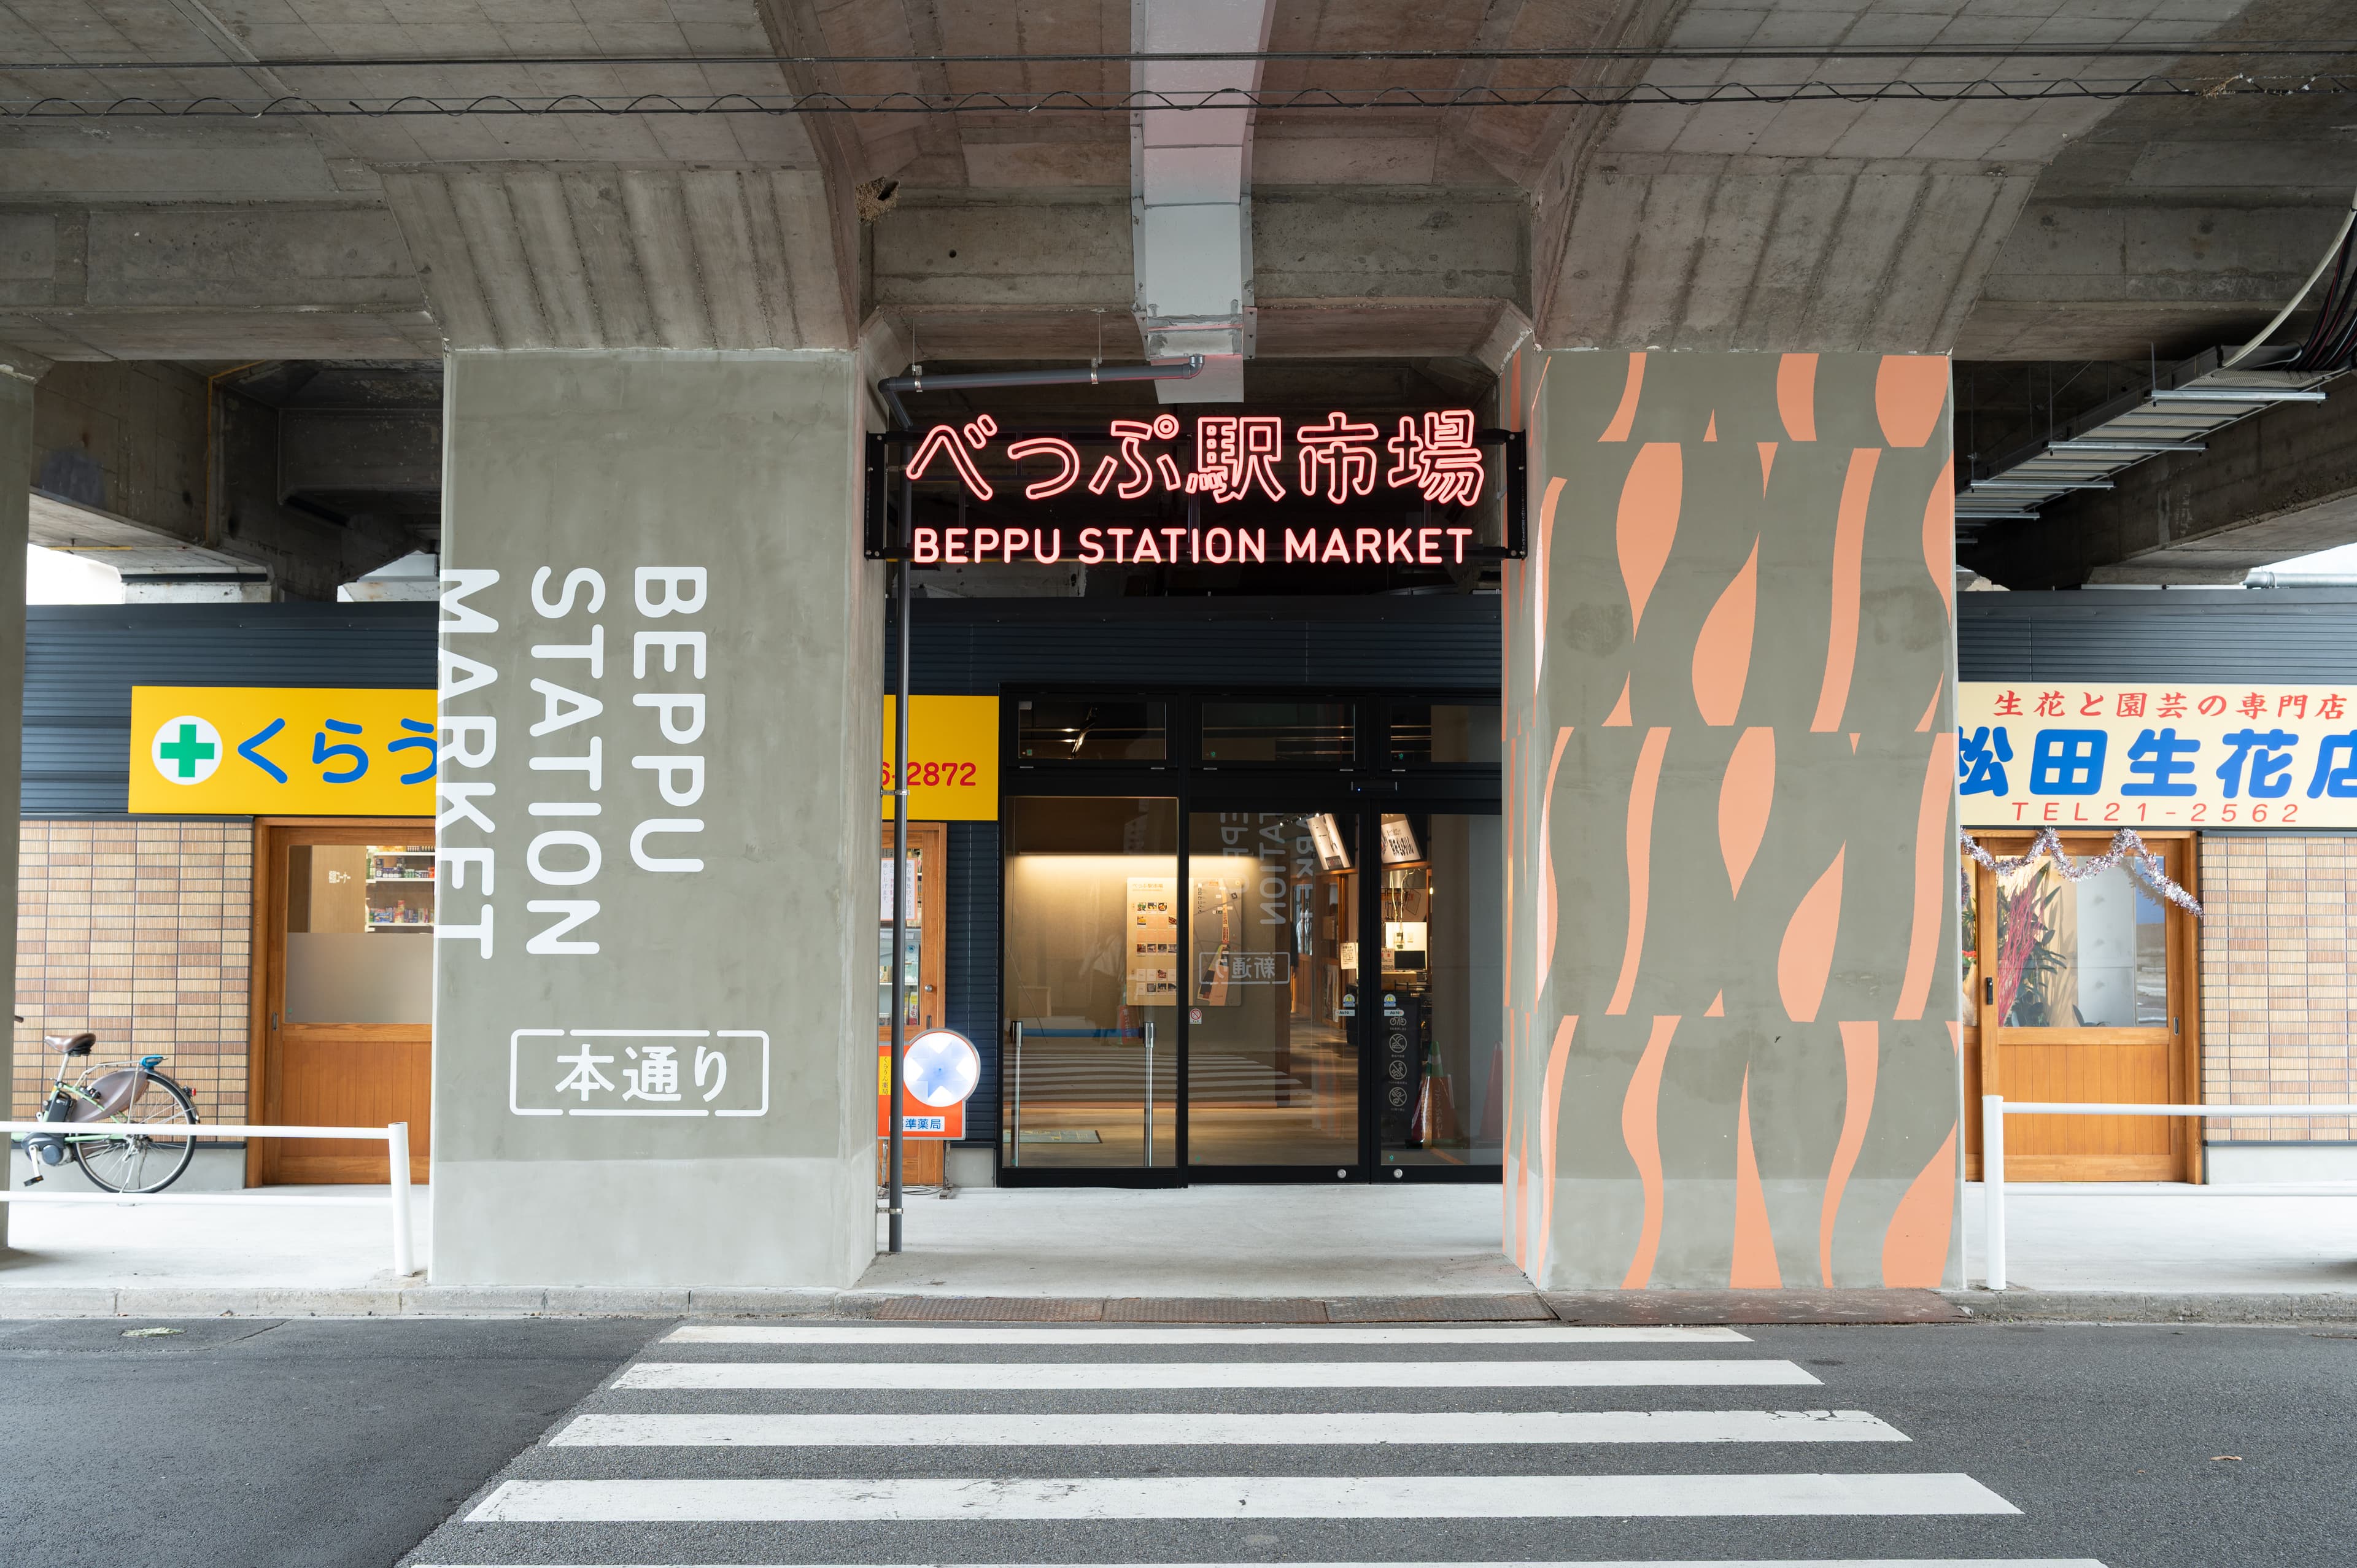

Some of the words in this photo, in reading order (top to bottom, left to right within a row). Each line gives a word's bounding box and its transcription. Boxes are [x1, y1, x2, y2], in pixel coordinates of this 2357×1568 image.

[906, 409, 1484, 507] べっぷ駅市場
[913, 527, 1061, 564] BEPPU
[1078, 526, 1266, 564] STATION
[1284, 527, 1473, 564] MARKET
[630, 566, 707, 872] BEPPU
[1993, 690, 2348, 720] 生花と園芸の専門店
[434, 569, 500, 959] MARKET
[527, 566, 606, 954] STATION
[882, 762, 976, 786] 2872
[1959, 726, 2357, 799] 松田生花店
[2011, 802, 2299, 823] TEL21-2562
[555, 1043, 727, 1102] 本通り
[902, 1118, 941, 1130] 準薬局
